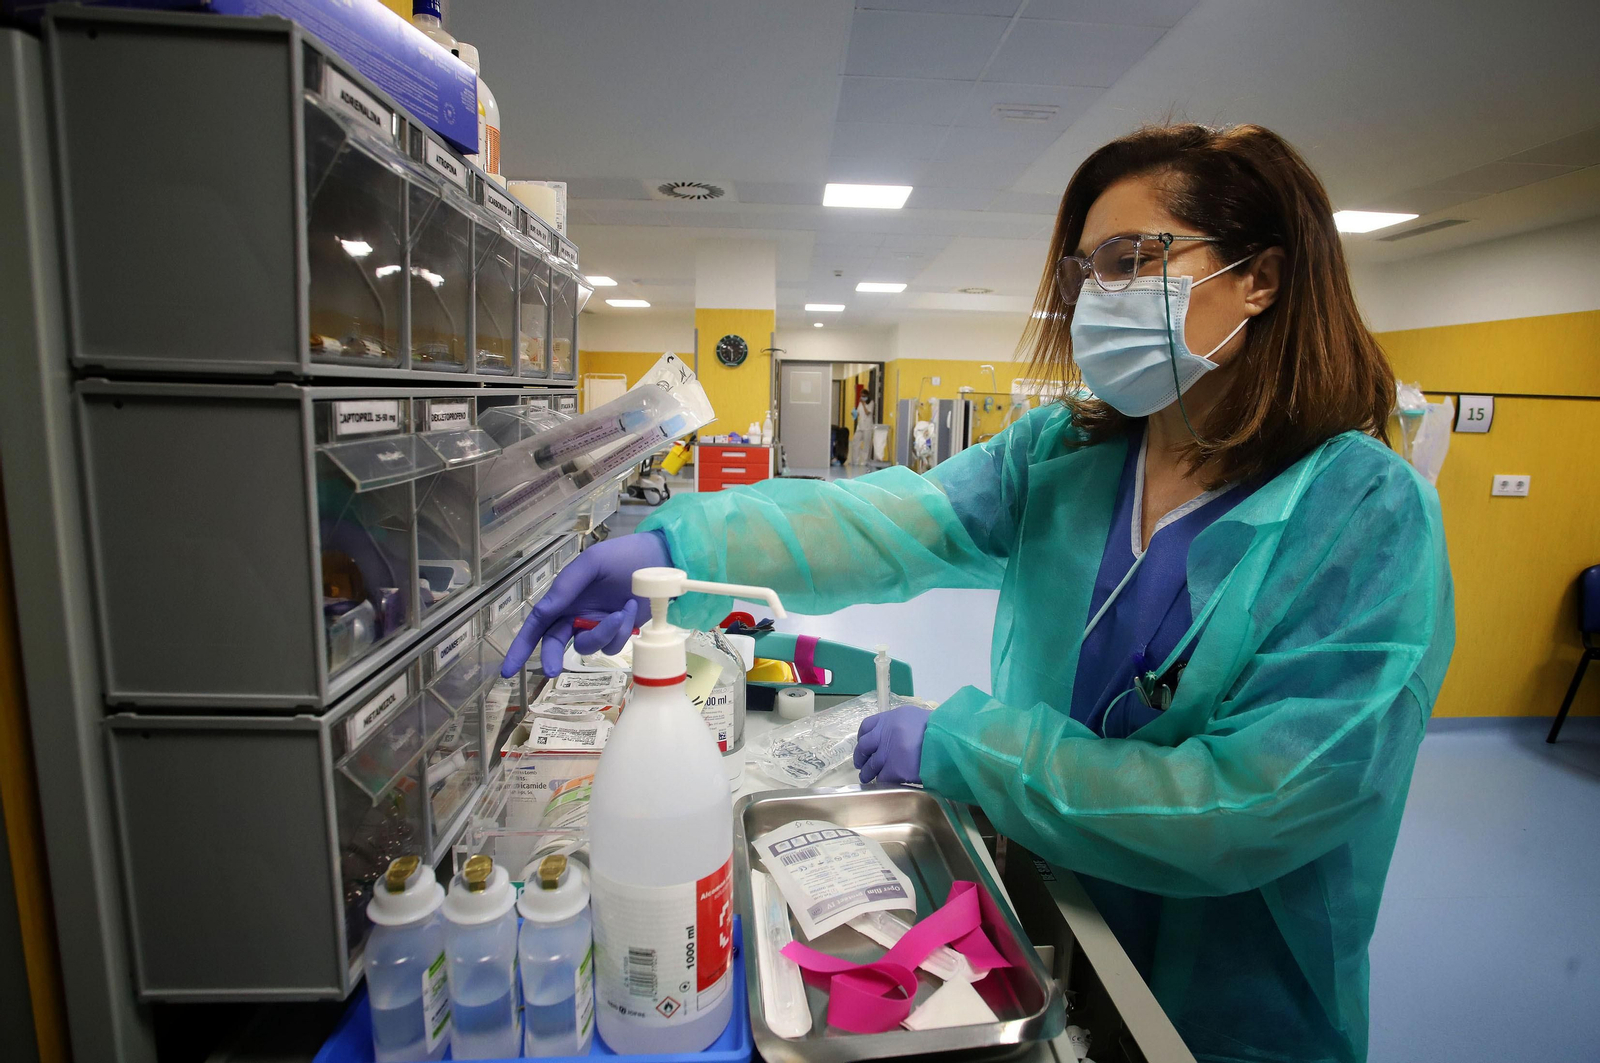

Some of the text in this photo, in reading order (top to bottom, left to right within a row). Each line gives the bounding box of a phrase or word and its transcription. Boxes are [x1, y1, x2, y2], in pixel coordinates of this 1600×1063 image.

[341, 90, 381, 127] ADRENALINA
[436, 155, 457, 176] ATROPINA
[1467, 408, 1485, 421] 15
[717, 695, 727, 705] ml
[363, 693, 396, 728] METAMIZOL
[866, 887, 882, 896] film
[883, 884, 901, 893] Oper
[686, 925, 695, 970] 1000 ml
